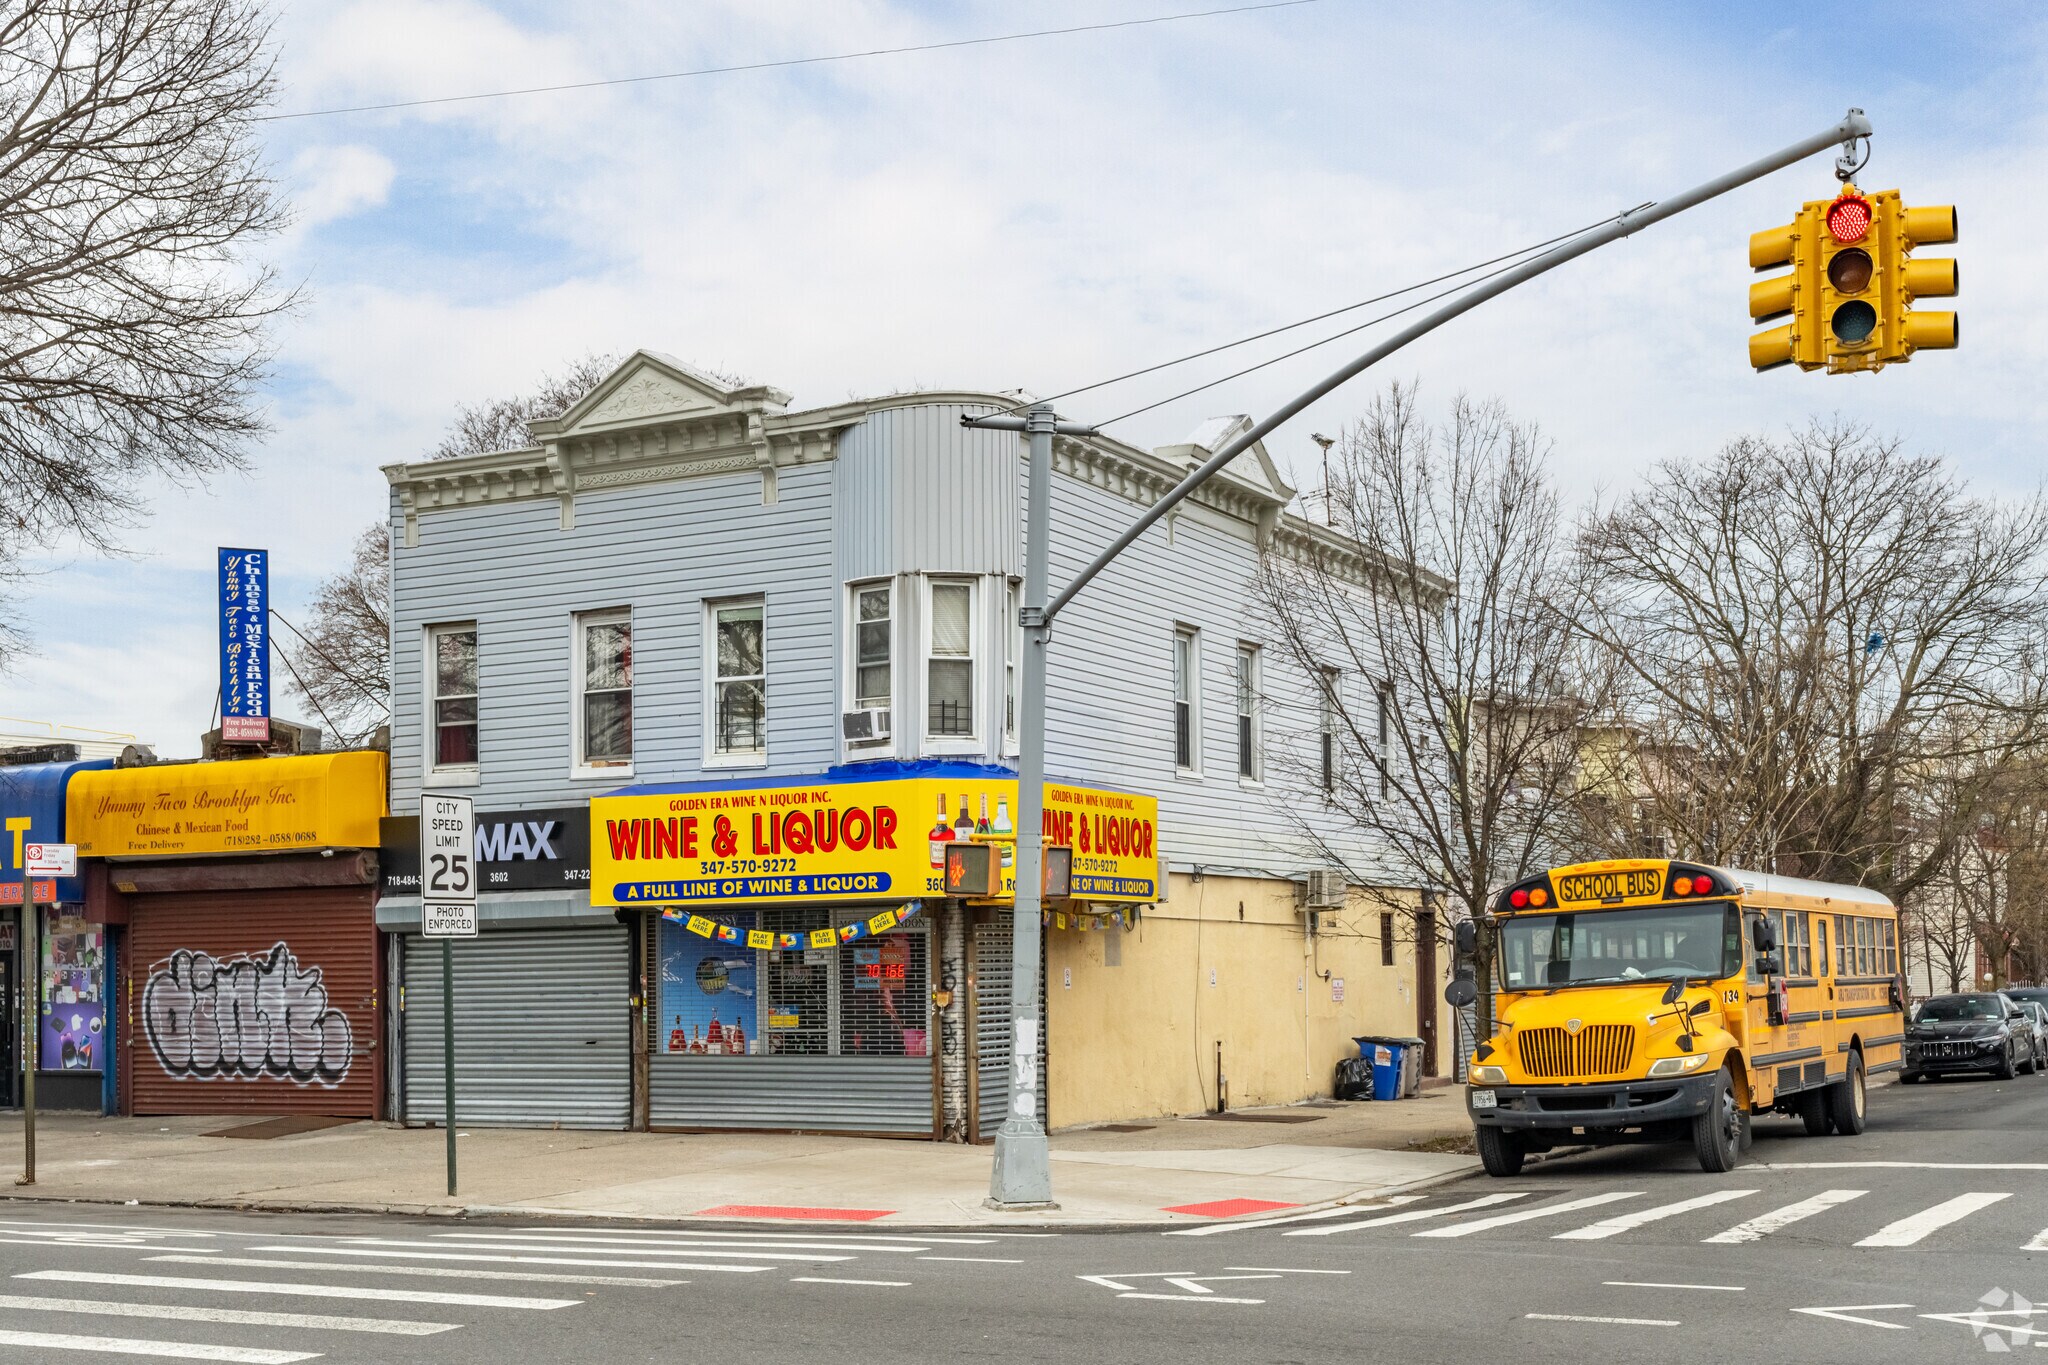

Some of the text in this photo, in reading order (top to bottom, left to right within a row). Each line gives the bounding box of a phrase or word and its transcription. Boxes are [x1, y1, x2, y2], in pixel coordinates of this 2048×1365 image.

[225, 555, 242, 713] Yummy Taco Brooklyn
[244, 553, 263, 716] Chinese & Mexican Food
[226, 718, 265, 728] Free Delivery
[94, 785, 296, 819] Yummy Taco Brooklyn Inc.
[669, 791, 832, 811] GOLDEN ERA WINE N LIQUOR INC.
[1052, 789, 1073, 803] GOLDEN
[1074, 792, 1084, 805] ERA
[1085, 794, 1098, 807] WINE
[1099, 796, 1104, 807] N
[1105, 796, 1123, 810] LIQUOR
[437, 802, 458, 815] CITY
[136, 818, 249, 836] Chinese & Mexican Food
[432, 818, 463, 831] SPEED
[606, 805, 898, 861] WINE & LIQUOR
[1079, 812, 1091, 854] &
[1095, 813, 1153, 859] LIQUOR
[128, 840, 185, 850] Free Delivery
[436, 835, 460, 848] LIMIT
[430, 853, 469, 892] 25
[700, 858, 796, 875] 347-570-9272
[1073, 857, 1118, 873] 47-570-9272
[387, 869, 590, 886] 718-484-3 3602 347-22-
[1071, 877, 1149, 894] NE OF WINE & LIQUOR
[1564, 870, 1655, 900] SCHOOL BUS
[627, 875, 879, 899] A FULL LINE OF WINE & LIQUOR
[437, 907, 464, 917] PHOTO
[873, 914, 888, 924] PLAY
[428, 919, 473, 929] ENFORCED
[694, 917, 709, 927] PLAY
[753, 932, 768, 940] PLAY
[814, 931, 829, 939] PLAY
[866, 964, 880, 978] 70
[1723, 989, 1739, 1004] 134
